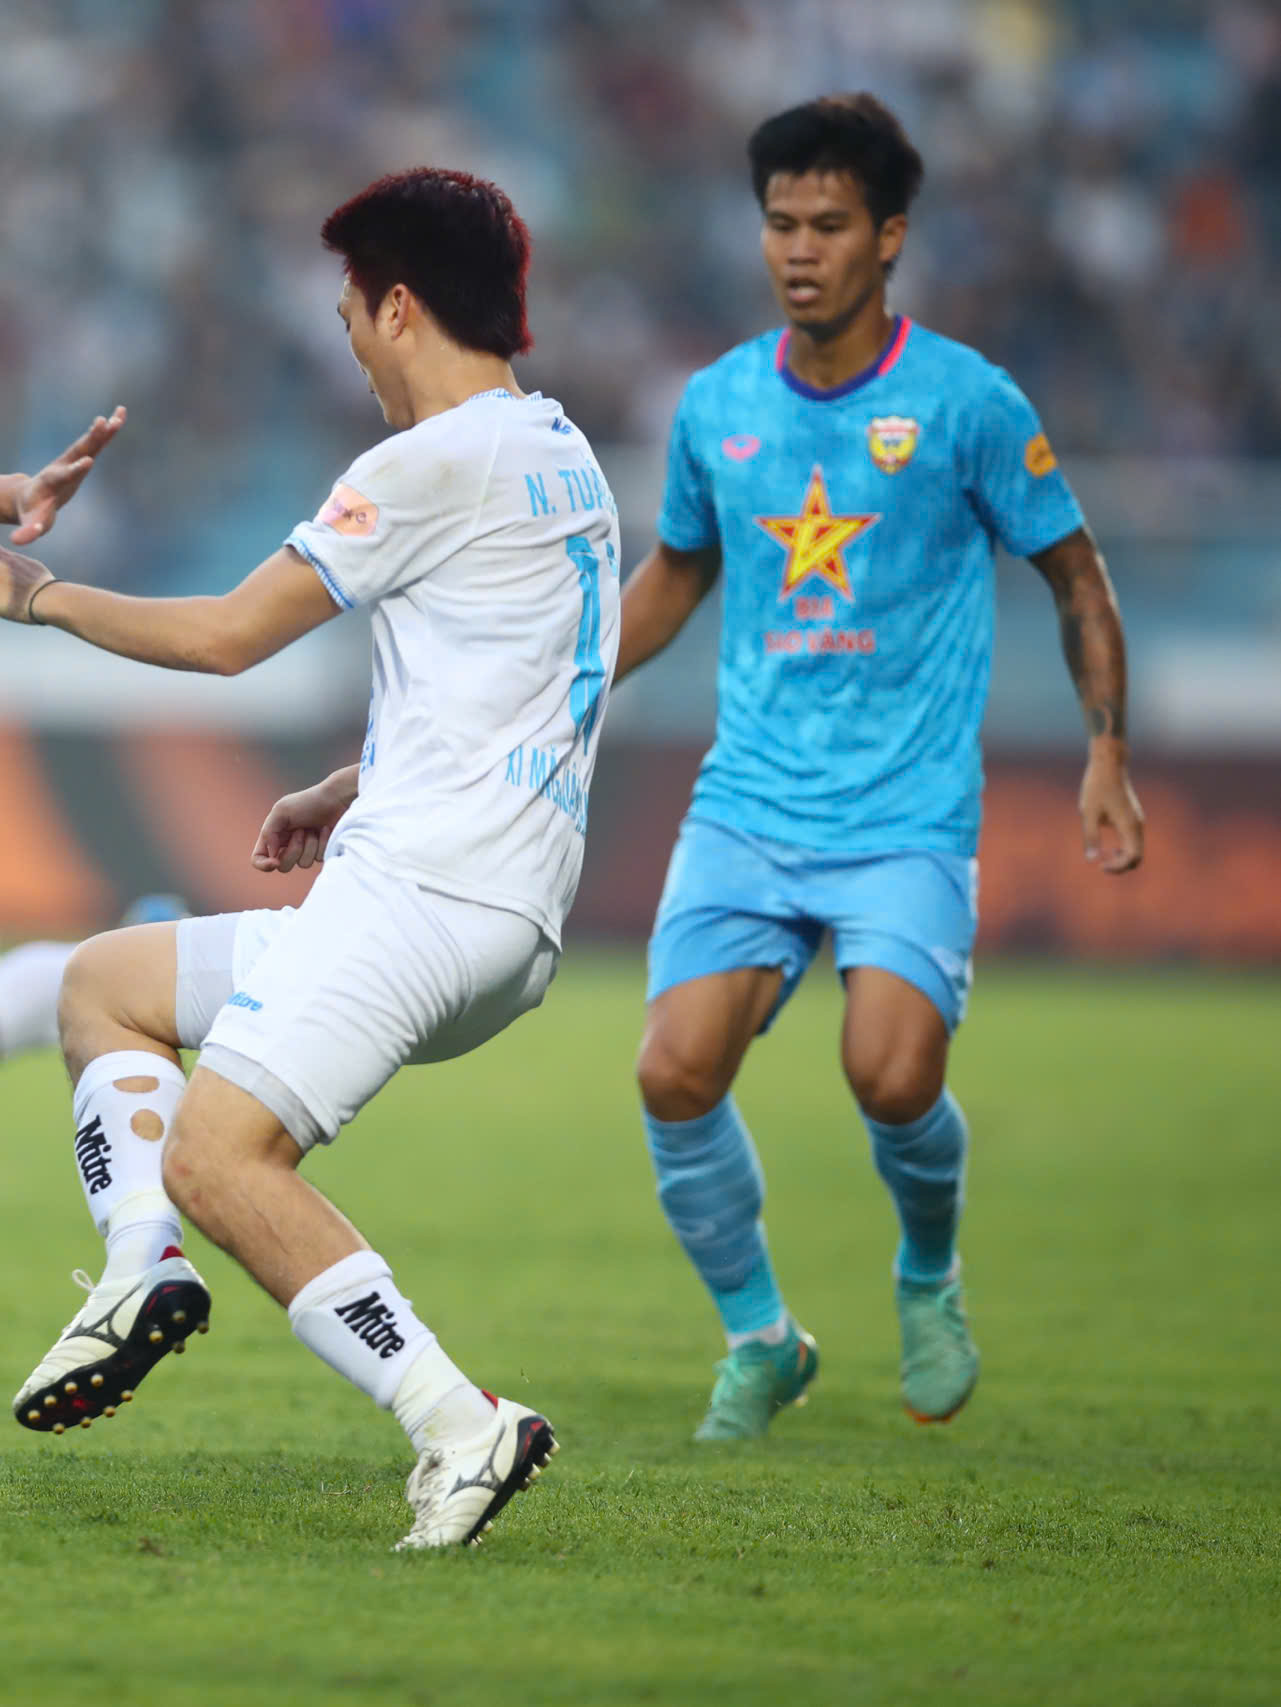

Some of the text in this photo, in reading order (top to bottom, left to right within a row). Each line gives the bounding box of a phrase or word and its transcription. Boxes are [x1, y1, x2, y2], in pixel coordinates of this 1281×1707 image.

[524, 472, 557, 517] N.
[74, 1114, 113, 1195] Mitre
[333, 1291, 406, 1359] Mitre
